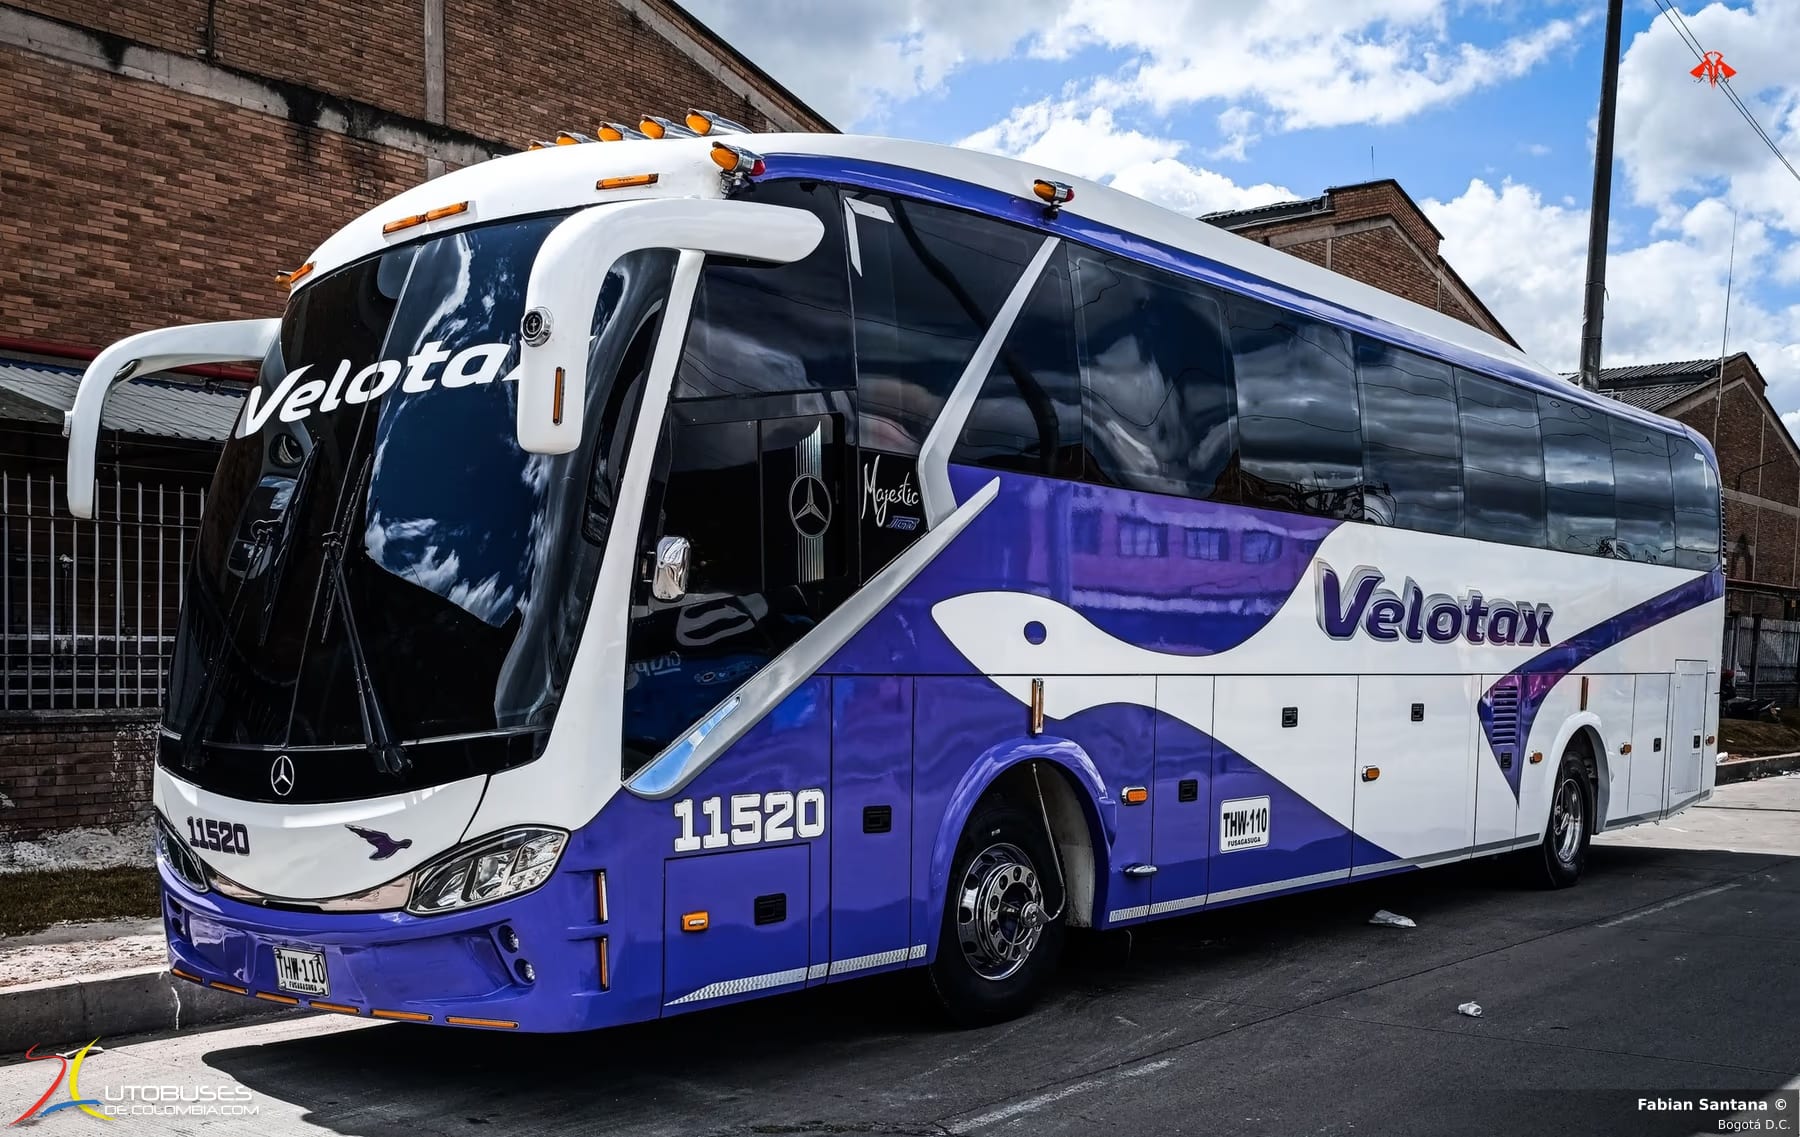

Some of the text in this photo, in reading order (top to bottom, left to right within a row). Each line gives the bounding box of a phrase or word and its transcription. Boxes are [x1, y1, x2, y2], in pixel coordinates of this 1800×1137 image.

[234, 340, 527, 439] Velota
[860, 454, 919, 527] Majestic
[1314, 557, 1554, 648] Velotax
[186, 815, 250, 856] 11520
[674, 787, 826, 852] 11520
